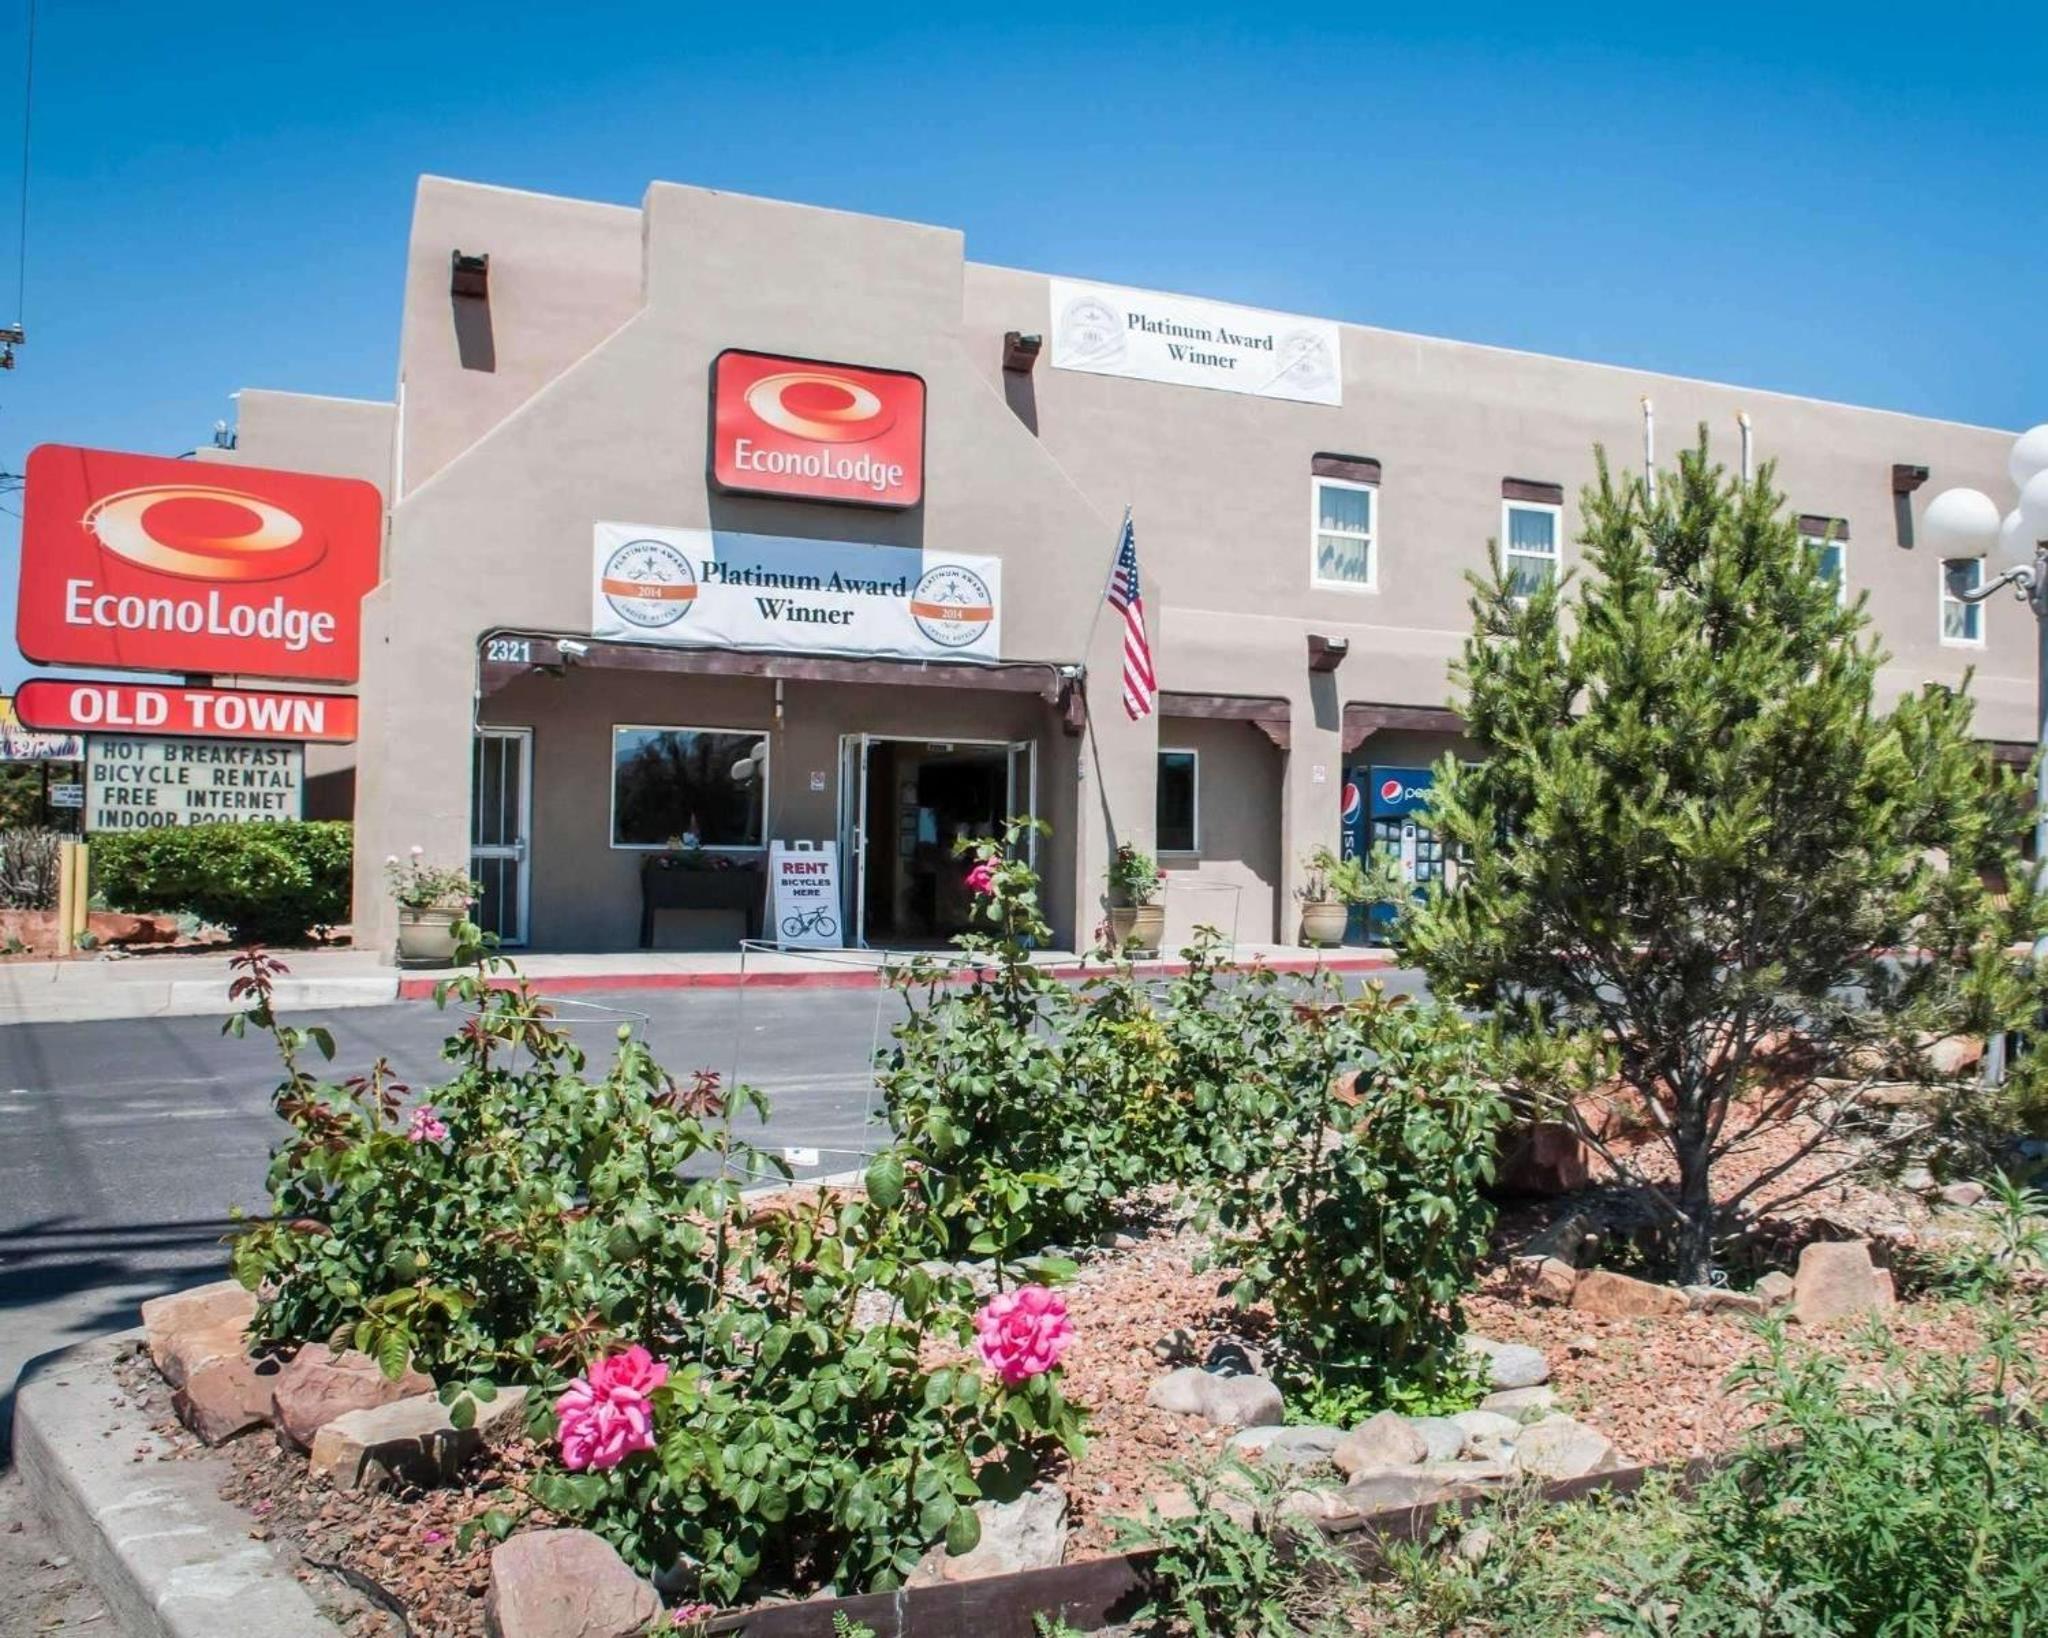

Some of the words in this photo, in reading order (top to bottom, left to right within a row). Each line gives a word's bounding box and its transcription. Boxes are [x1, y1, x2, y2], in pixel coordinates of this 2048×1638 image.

[1127, 312, 1212, 341] Platinum
[1215, 328, 1273, 351] Award
[1167, 343, 1238, 369] Winner
[734, 438, 903, 491] EconoLodge
[700, 560, 820, 592] Platinum
[824, 570, 907, 597] Award
[638, 586, 662, 598] 2014
[65, 578, 336, 651] EconoLodge
[756, 597, 855, 625] Winner
[942, 608, 963, 619] 2014
[487, 640, 531, 662] 2321
[69, 687, 169, 726] OLD
[185, 694, 325, 734] TOWN
[103, 742, 148, 761] HOT
[164, 744, 292, 766] BREAKFAST
[94, 765, 190, 785] BICYCLE
[213, 768, 295, 788] RENTAL
[103, 787, 158, 806] FREE
[186, 790, 287, 810] INTERNET
[98, 810, 178, 829] INDOOR
[783, 862, 828, 874] RENT
[781, 879, 831, 887] BICYCLES
